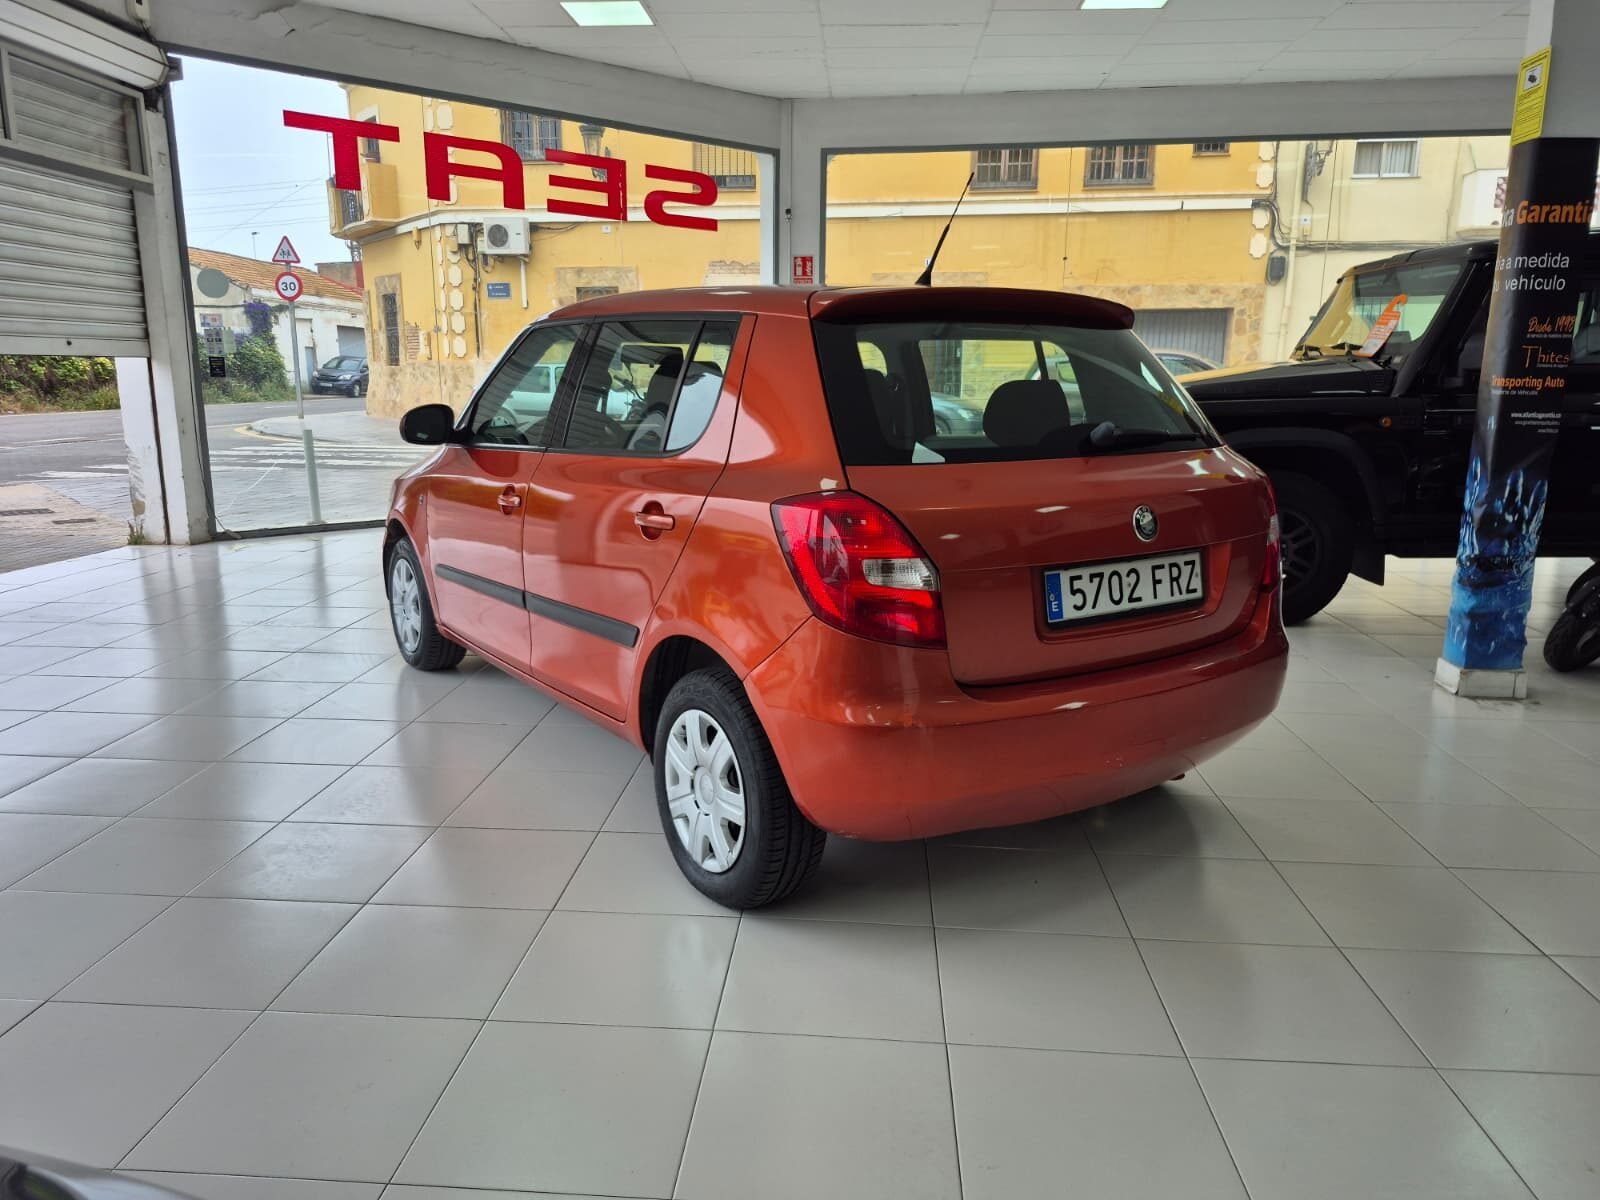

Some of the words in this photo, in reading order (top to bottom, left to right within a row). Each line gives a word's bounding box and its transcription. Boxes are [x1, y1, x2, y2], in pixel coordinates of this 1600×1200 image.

[1514, 252, 1570, 269] medida
[281, 281, 297, 292] 30
[1505, 273, 1566, 291] vehículo
[1544, 376, 1565, 388] Auto
[1068, 567, 1143, 612] 5702
[1151, 560, 1198, 600] FRZ
